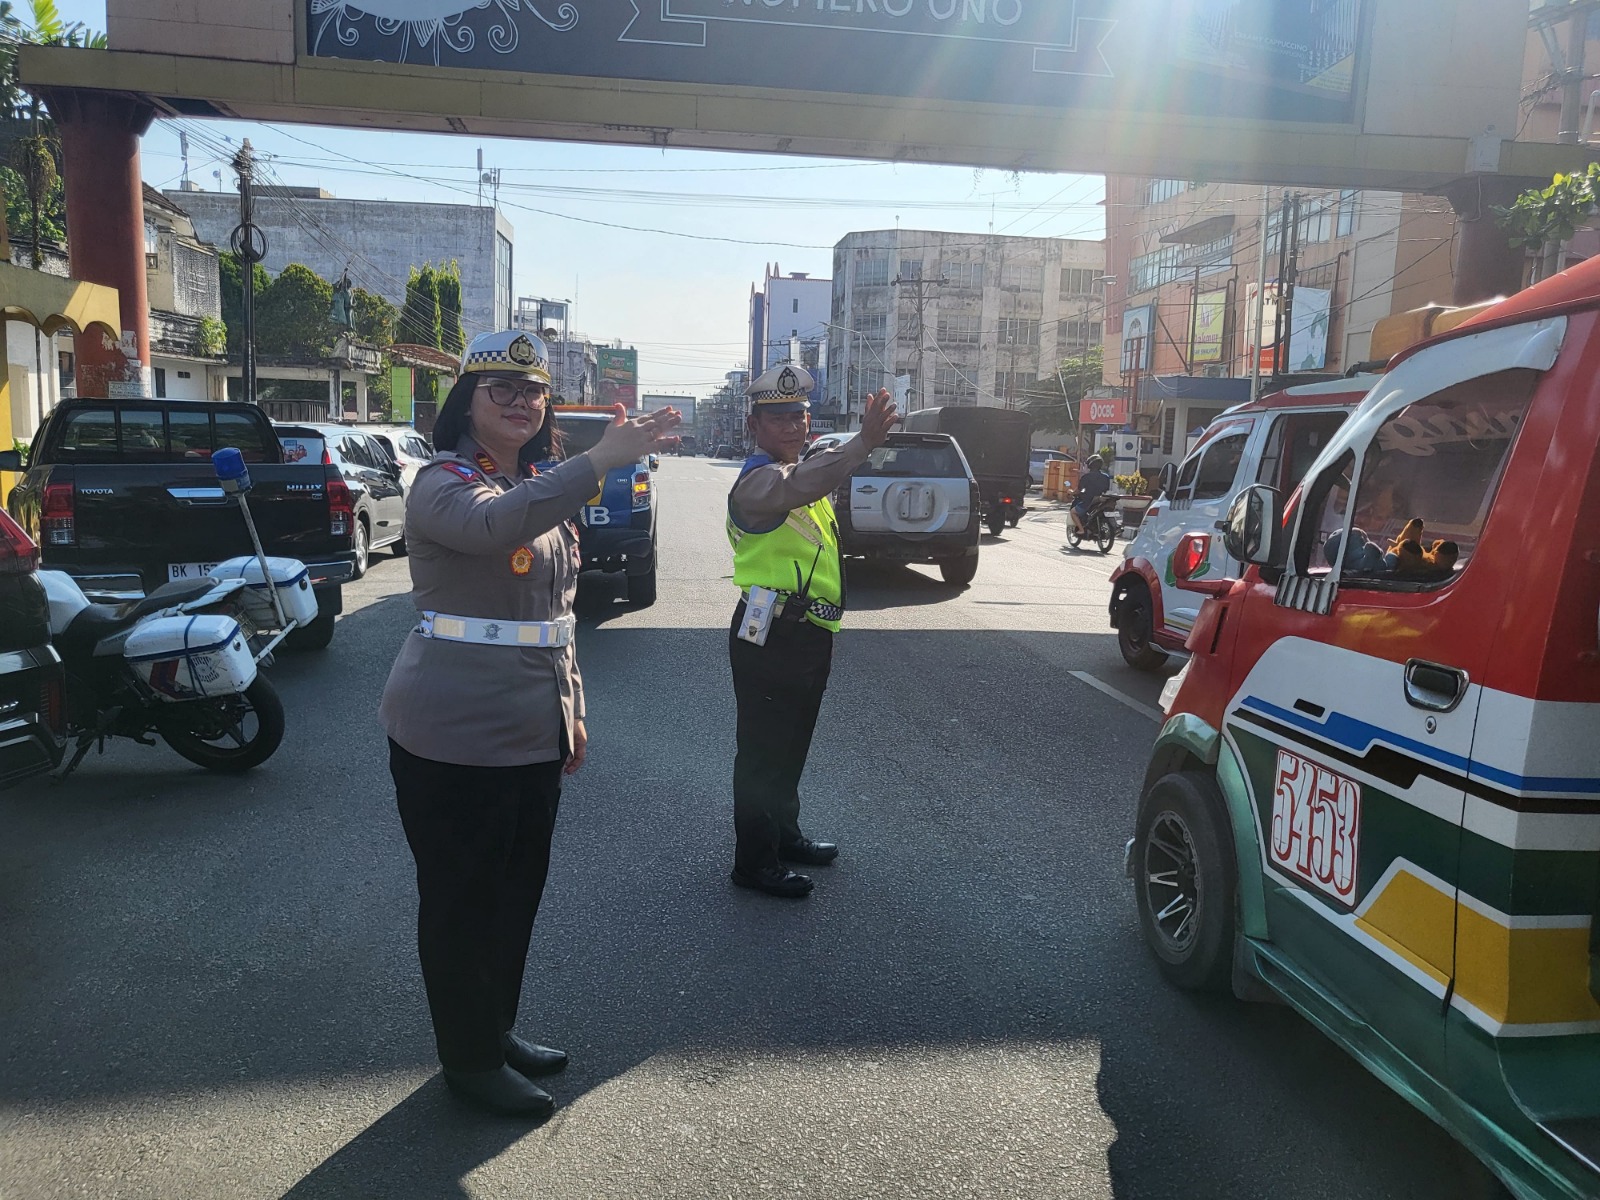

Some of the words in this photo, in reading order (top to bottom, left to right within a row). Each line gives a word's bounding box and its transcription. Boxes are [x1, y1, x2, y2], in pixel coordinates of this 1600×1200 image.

[1264, 37, 1308, 52] CAPPUCCINO
[1097, 404, 1115, 418] OCBC
[172, 565, 188, 578] BK
[1273, 751, 1358, 896] 5453
